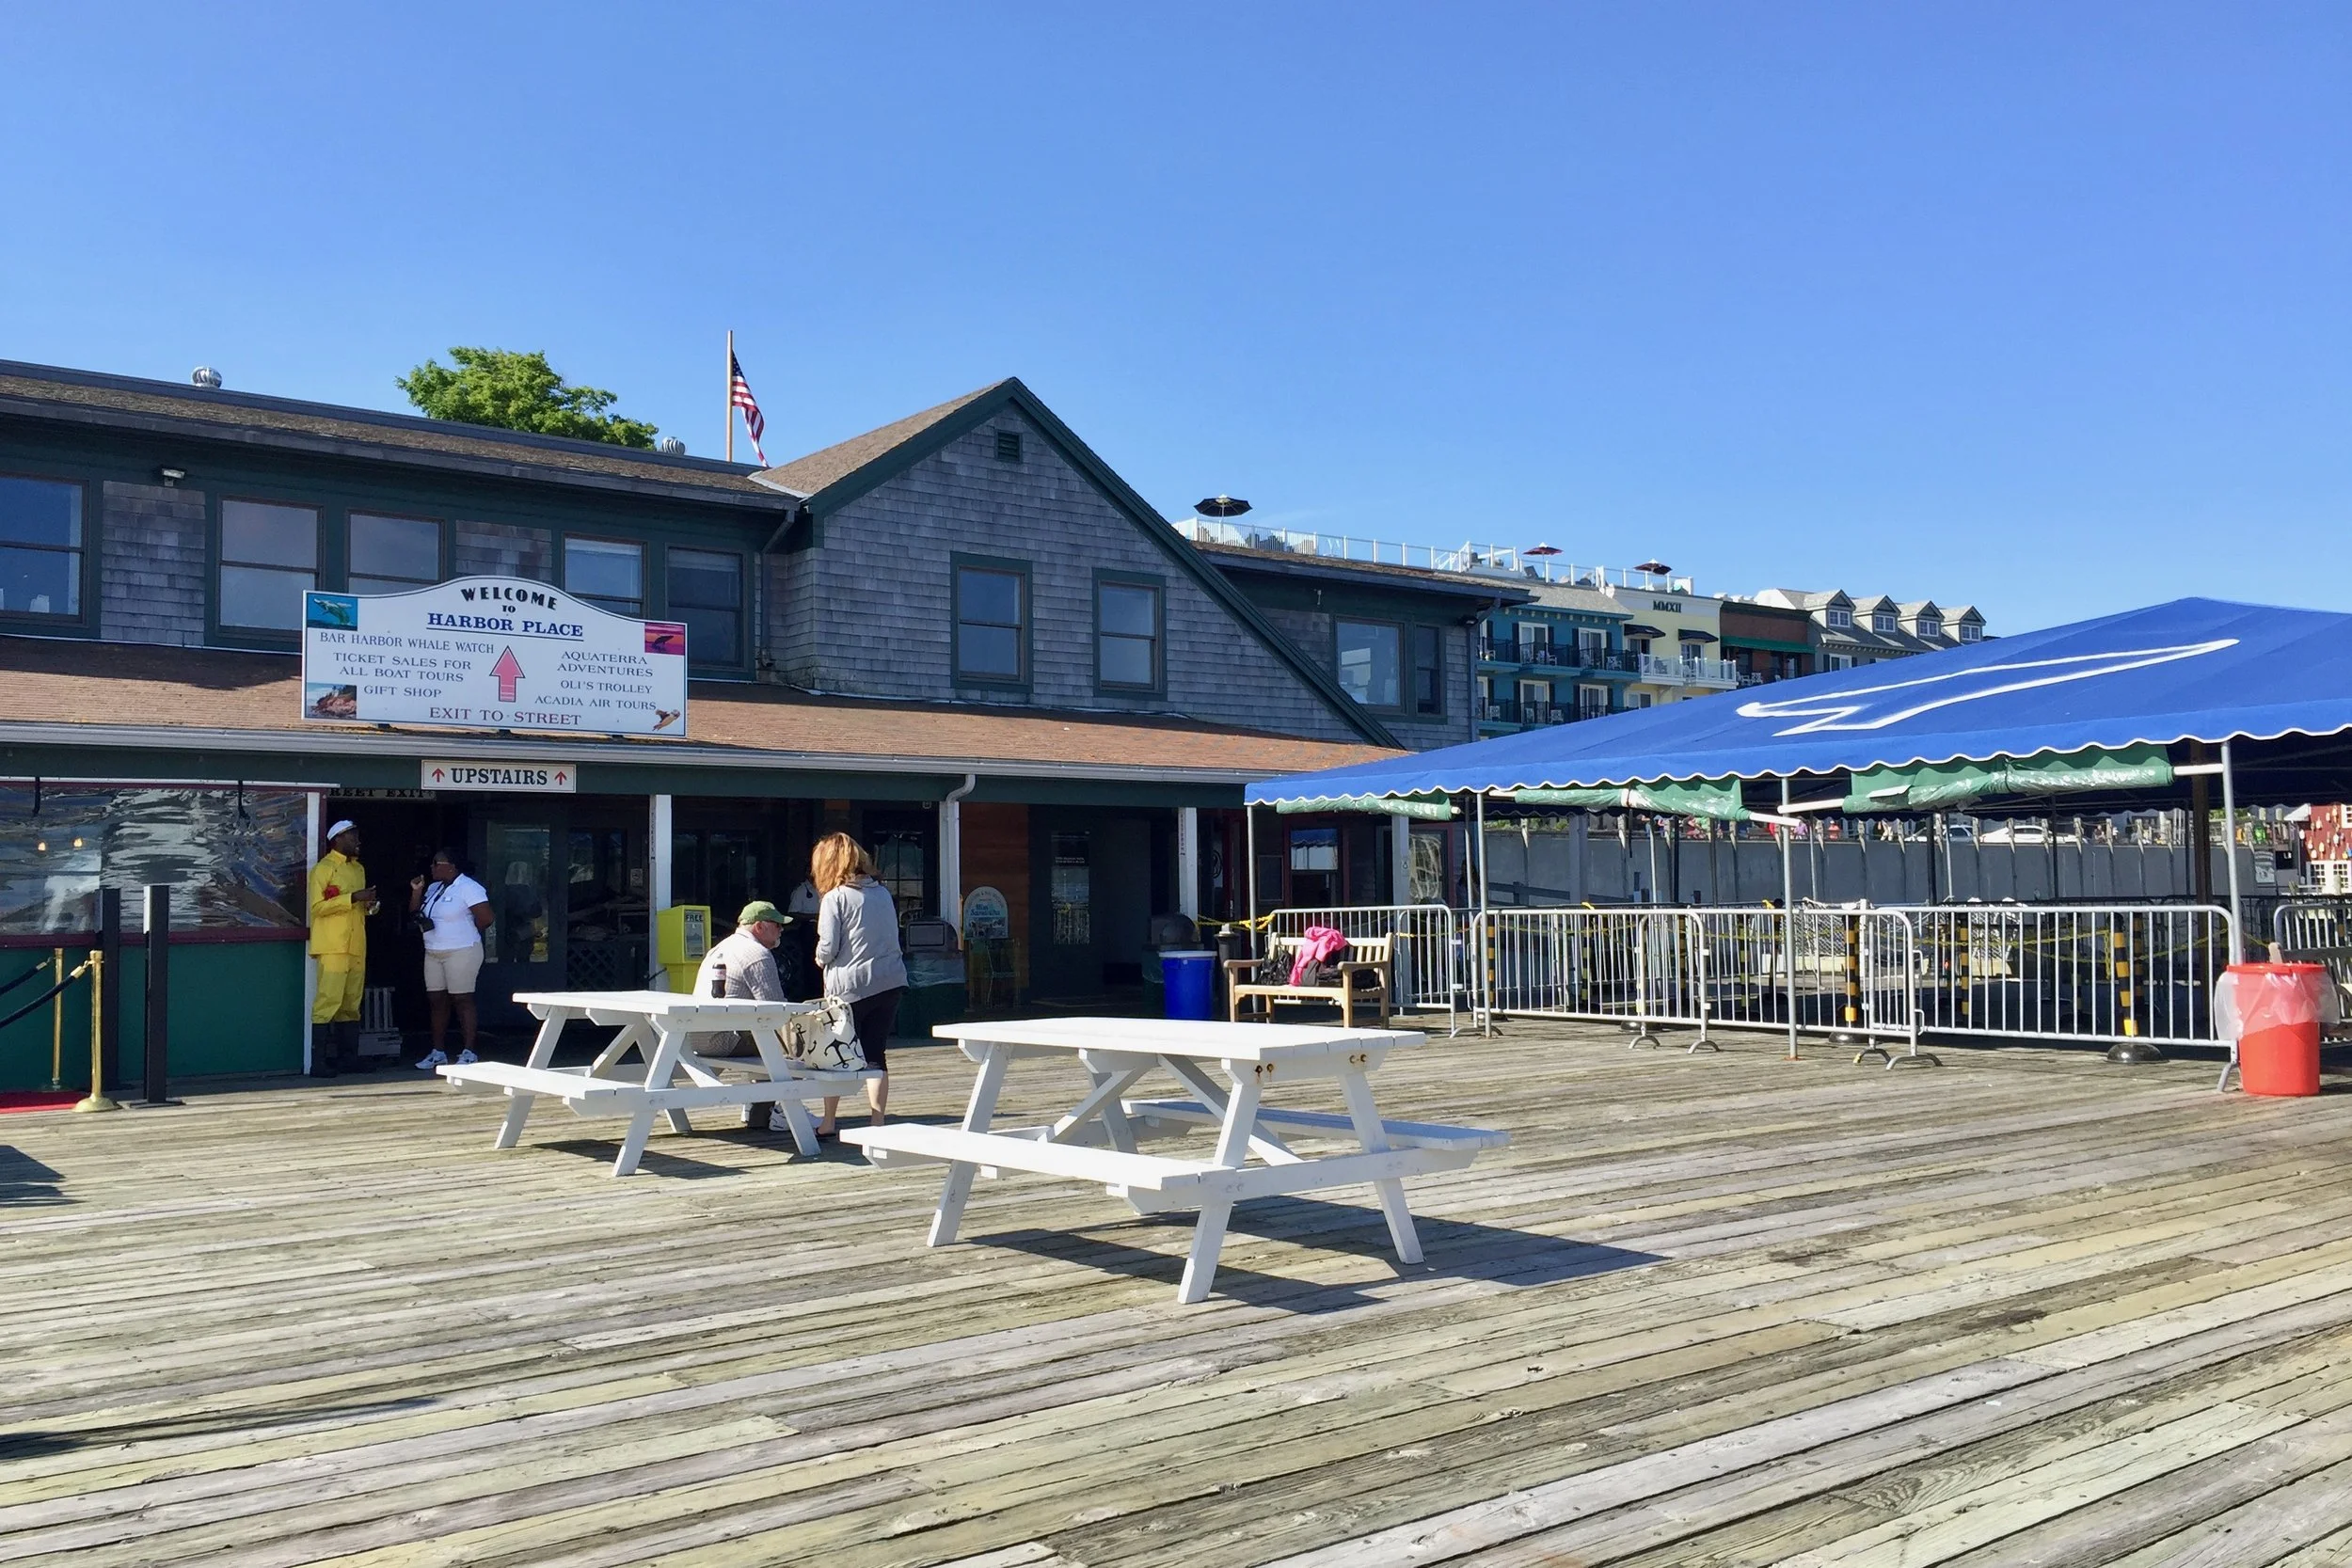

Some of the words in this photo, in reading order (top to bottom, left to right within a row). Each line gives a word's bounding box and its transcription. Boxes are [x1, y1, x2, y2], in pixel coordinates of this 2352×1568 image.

[460, 586, 557, 610] WELCOME
[501, 605, 516, 613] TO
[1652, 599, 1681, 613] MMXII
[427, 612, 514, 631] HARBOR
[522, 620, 583, 637] PLACE
[320, 631, 345, 643] BAR
[351, 634, 403, 647] HARBOR
[407, 638, 451, 651] WHALE
[455, 641, 494, 654] WATCH
[333, 652, 386, 664] TICKET
[391, 656, 437, 668] SALES
[444, 659, 471, 670] FOR
[561, 651, 647, 665] AQUATERRA
[339, 666, 368, 676] ALL
[374, 668, 411, 679] BOAT
[417, 671, 464, 683] TOURS
[557, 662, 653, 677] ADVENTURES
[363, 685, 401, 696] GIFT
[404, 687, 442, 698] SHOP
[560, 679, 594, 690] OLI'S
[597, 682, 652, 694] TROLLEY
[534, 695, 583, 706] ACADIA
[589, 698, 611, 708] AIR
[615, 699, 657, 710] TOURS
[429, 706, 471, 721] EXIT
[480, 709, 503, 721] TO
[514, 711, 581, 725] STREET
[451, 768, 548, 785] UPSTAIRS
[686, 913, 704, 922] FREE
